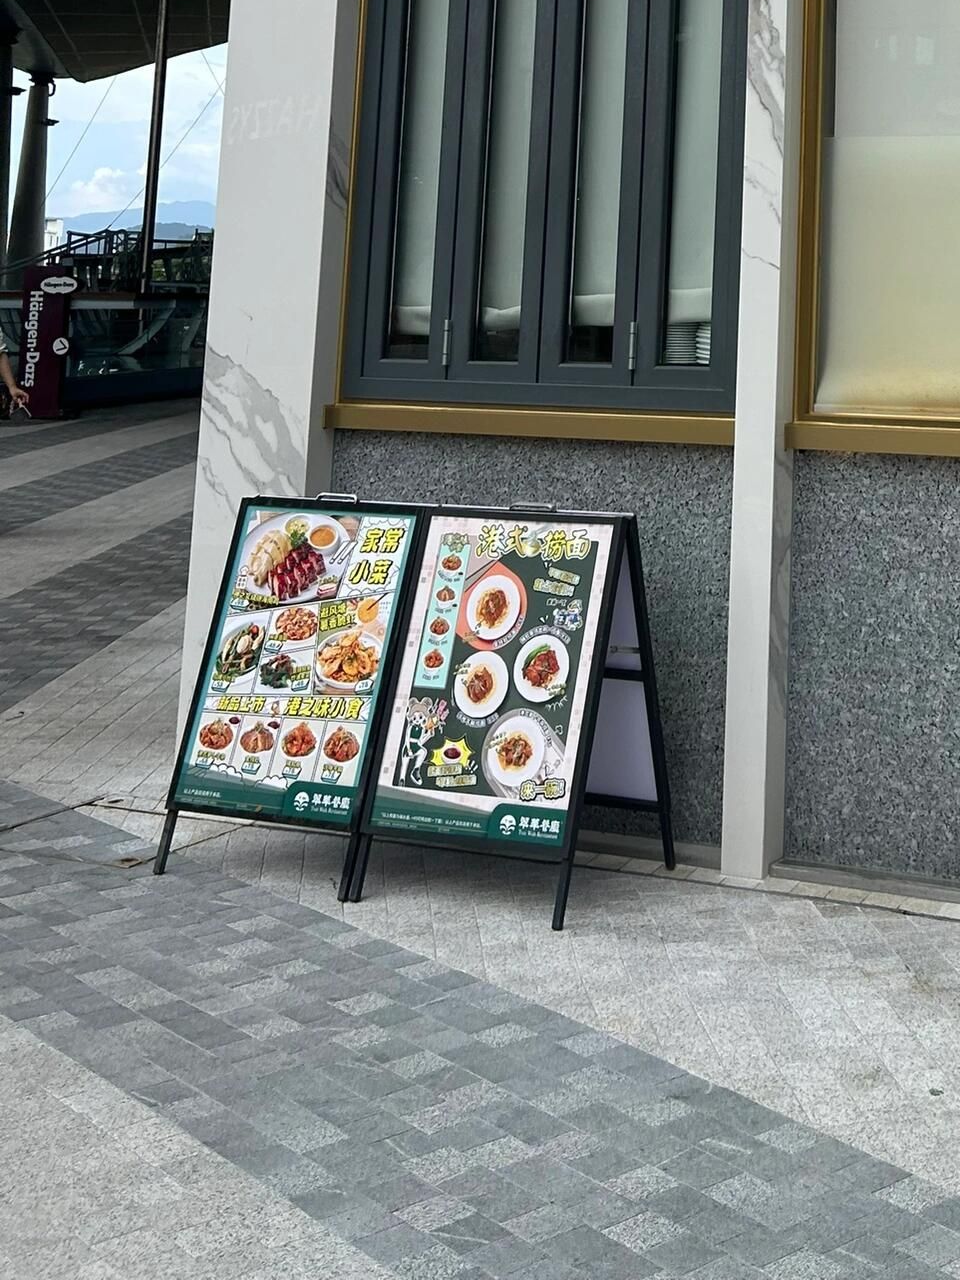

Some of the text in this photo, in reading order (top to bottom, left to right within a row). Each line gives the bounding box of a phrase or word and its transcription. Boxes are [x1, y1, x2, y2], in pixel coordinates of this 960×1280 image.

[360, 527, 405, 554] 家常
[349, 559, 393, 585] 小菜
[216, 695, 364, 720] 新品上市 港之味小食
